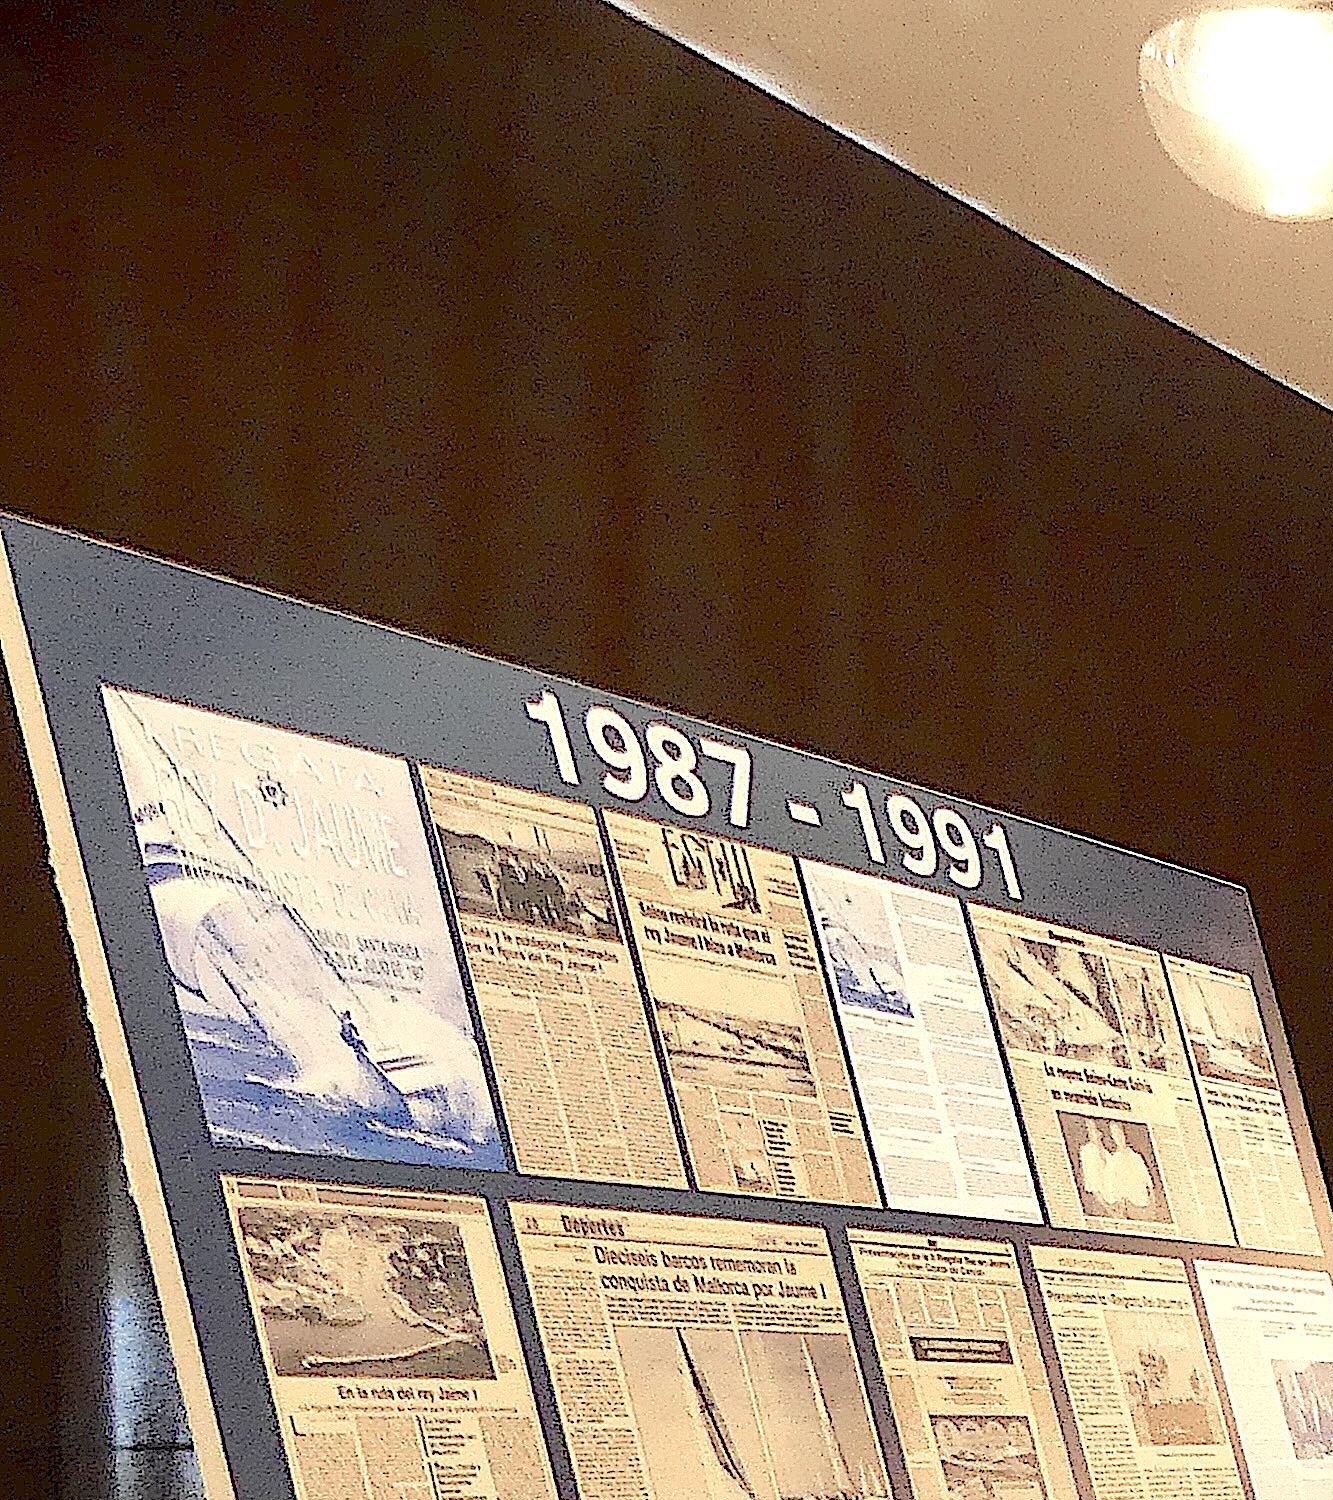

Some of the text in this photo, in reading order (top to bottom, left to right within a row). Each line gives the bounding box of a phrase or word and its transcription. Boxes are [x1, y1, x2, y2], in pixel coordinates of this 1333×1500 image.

[524, 689, 752, 828] 1987
[787, 799, 822, 828] -
[841, 782, 1023, 901] 1991
[561, 1214, 625, 1238] Deportes
[662, 1250, 706, 1272] barcos
[709, 1256, 781, 1276] rememoran
[784, 1260, 798, 1277] la
[600, 1272, 670, 1298] conquista
[673, 1276, 690, 1294] de
[696, 1273, 750, 1297] Mallorca
[754, 1282, 774, 1301] por
[778, 1280, 817, 1301] Jaume
